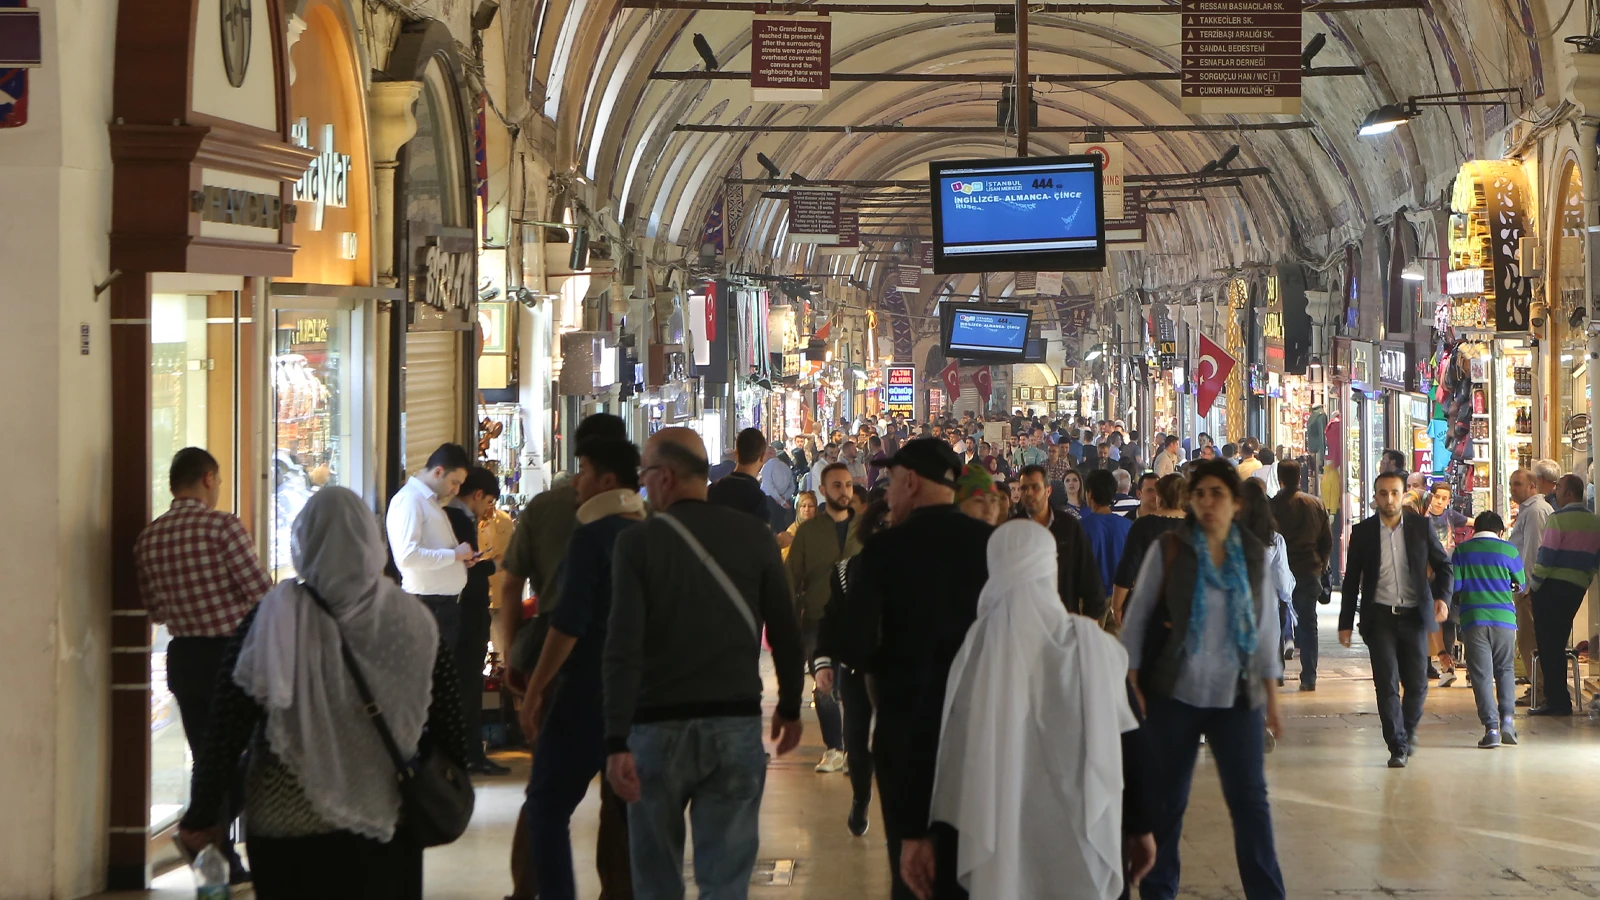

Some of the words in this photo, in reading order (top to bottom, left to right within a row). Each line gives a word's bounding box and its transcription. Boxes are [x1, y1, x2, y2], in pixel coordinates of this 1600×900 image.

[1200, 15, 1241, 24] TAKKECİLER
[1200, 29, 1234, 39] TERZİBAŞI
[1235, 29, 1262, 38] ARALIĞI
[1228, 43, 1265, 52] BEDESTENİ
[1236, 57, 1265, 66] DERNEĞİ
[1200, 73, 1236, 82] SORGUÇLU
[1200, 87, 1223, 96] ÇUKUR
[1031, 178, 1053, 189] 444
[1005, 193, 1051, 201] ALMANCA-
[1054, 192, 1082, 200] ÇİNCE
[202, 185, 281, 229] HAYDAR
[889, 387, 912, 395] GÜMÜŞ
